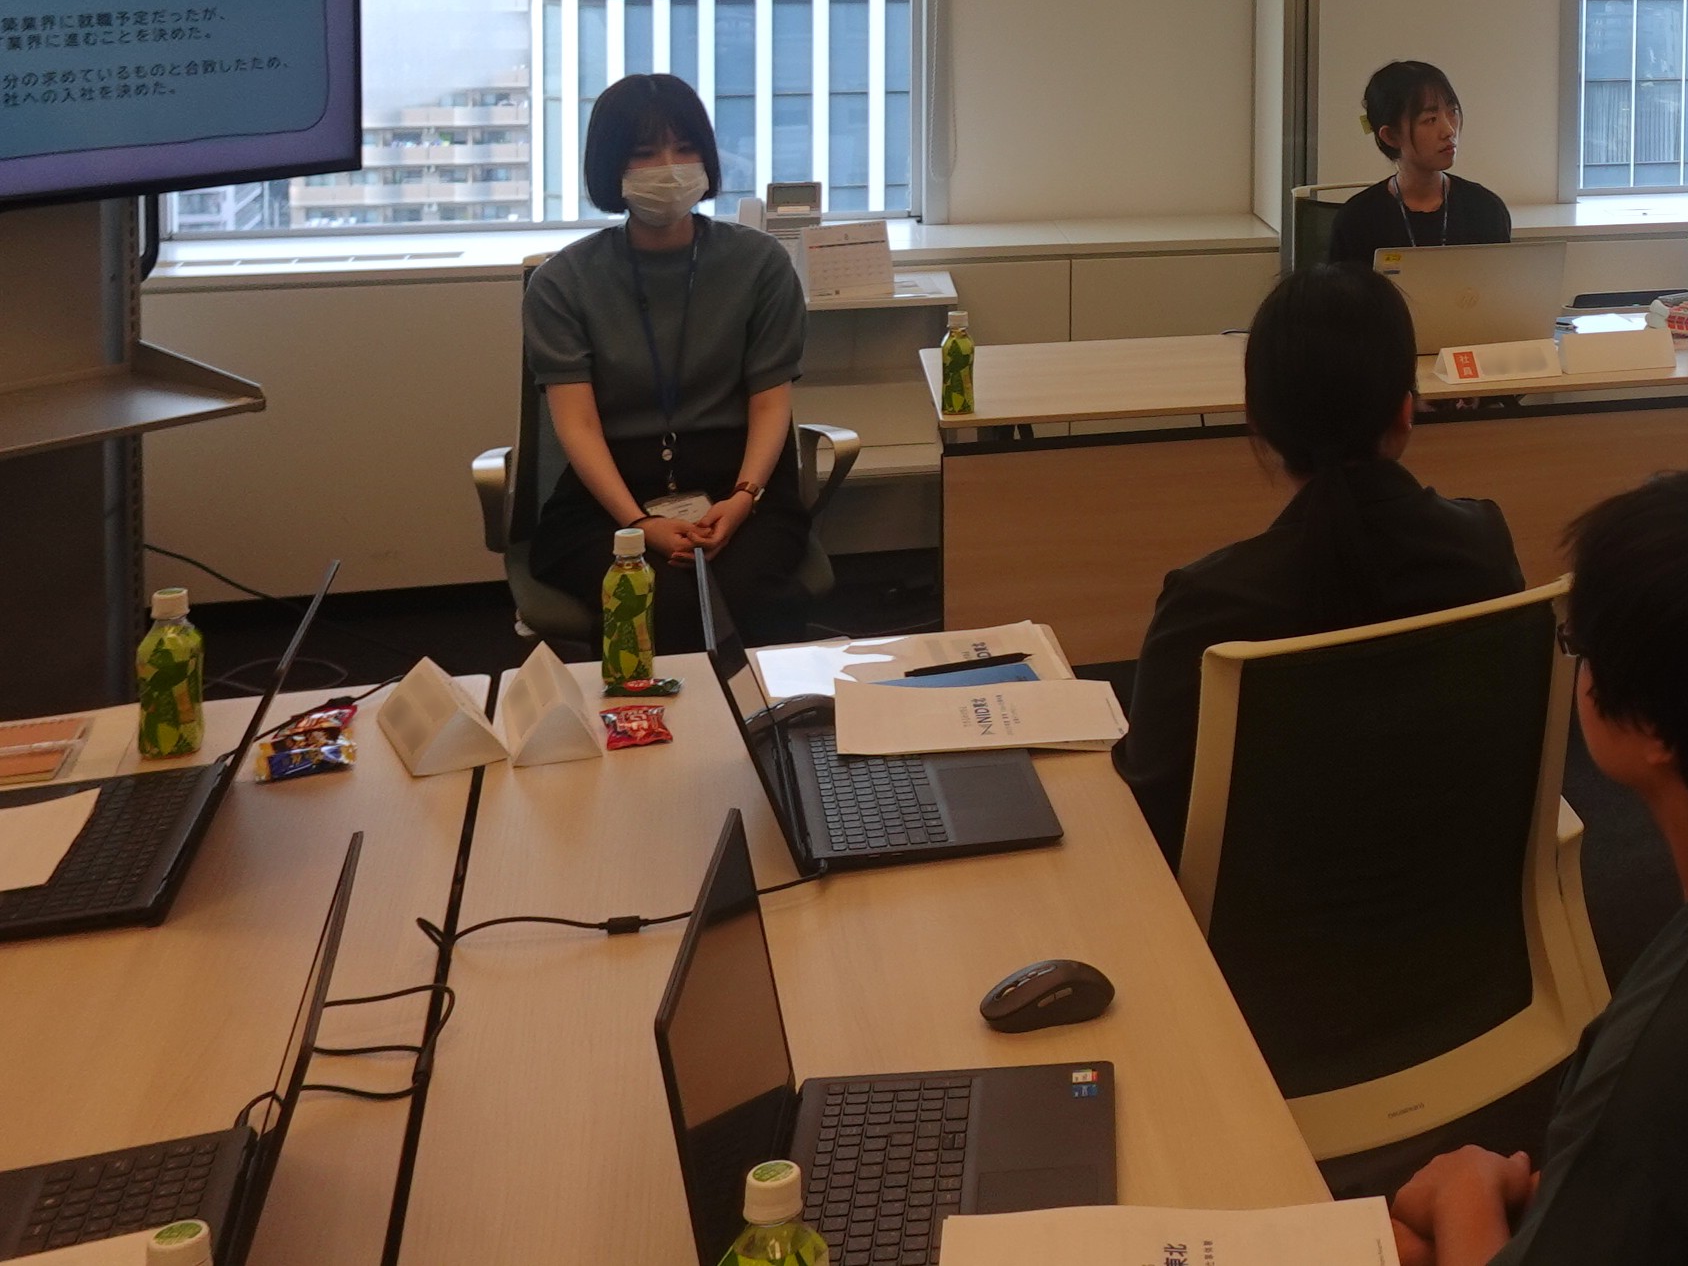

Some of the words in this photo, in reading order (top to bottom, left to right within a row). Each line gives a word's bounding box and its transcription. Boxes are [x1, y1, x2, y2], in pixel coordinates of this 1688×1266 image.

[0, 27, 212, 50] 業界に進むことを決めた。
